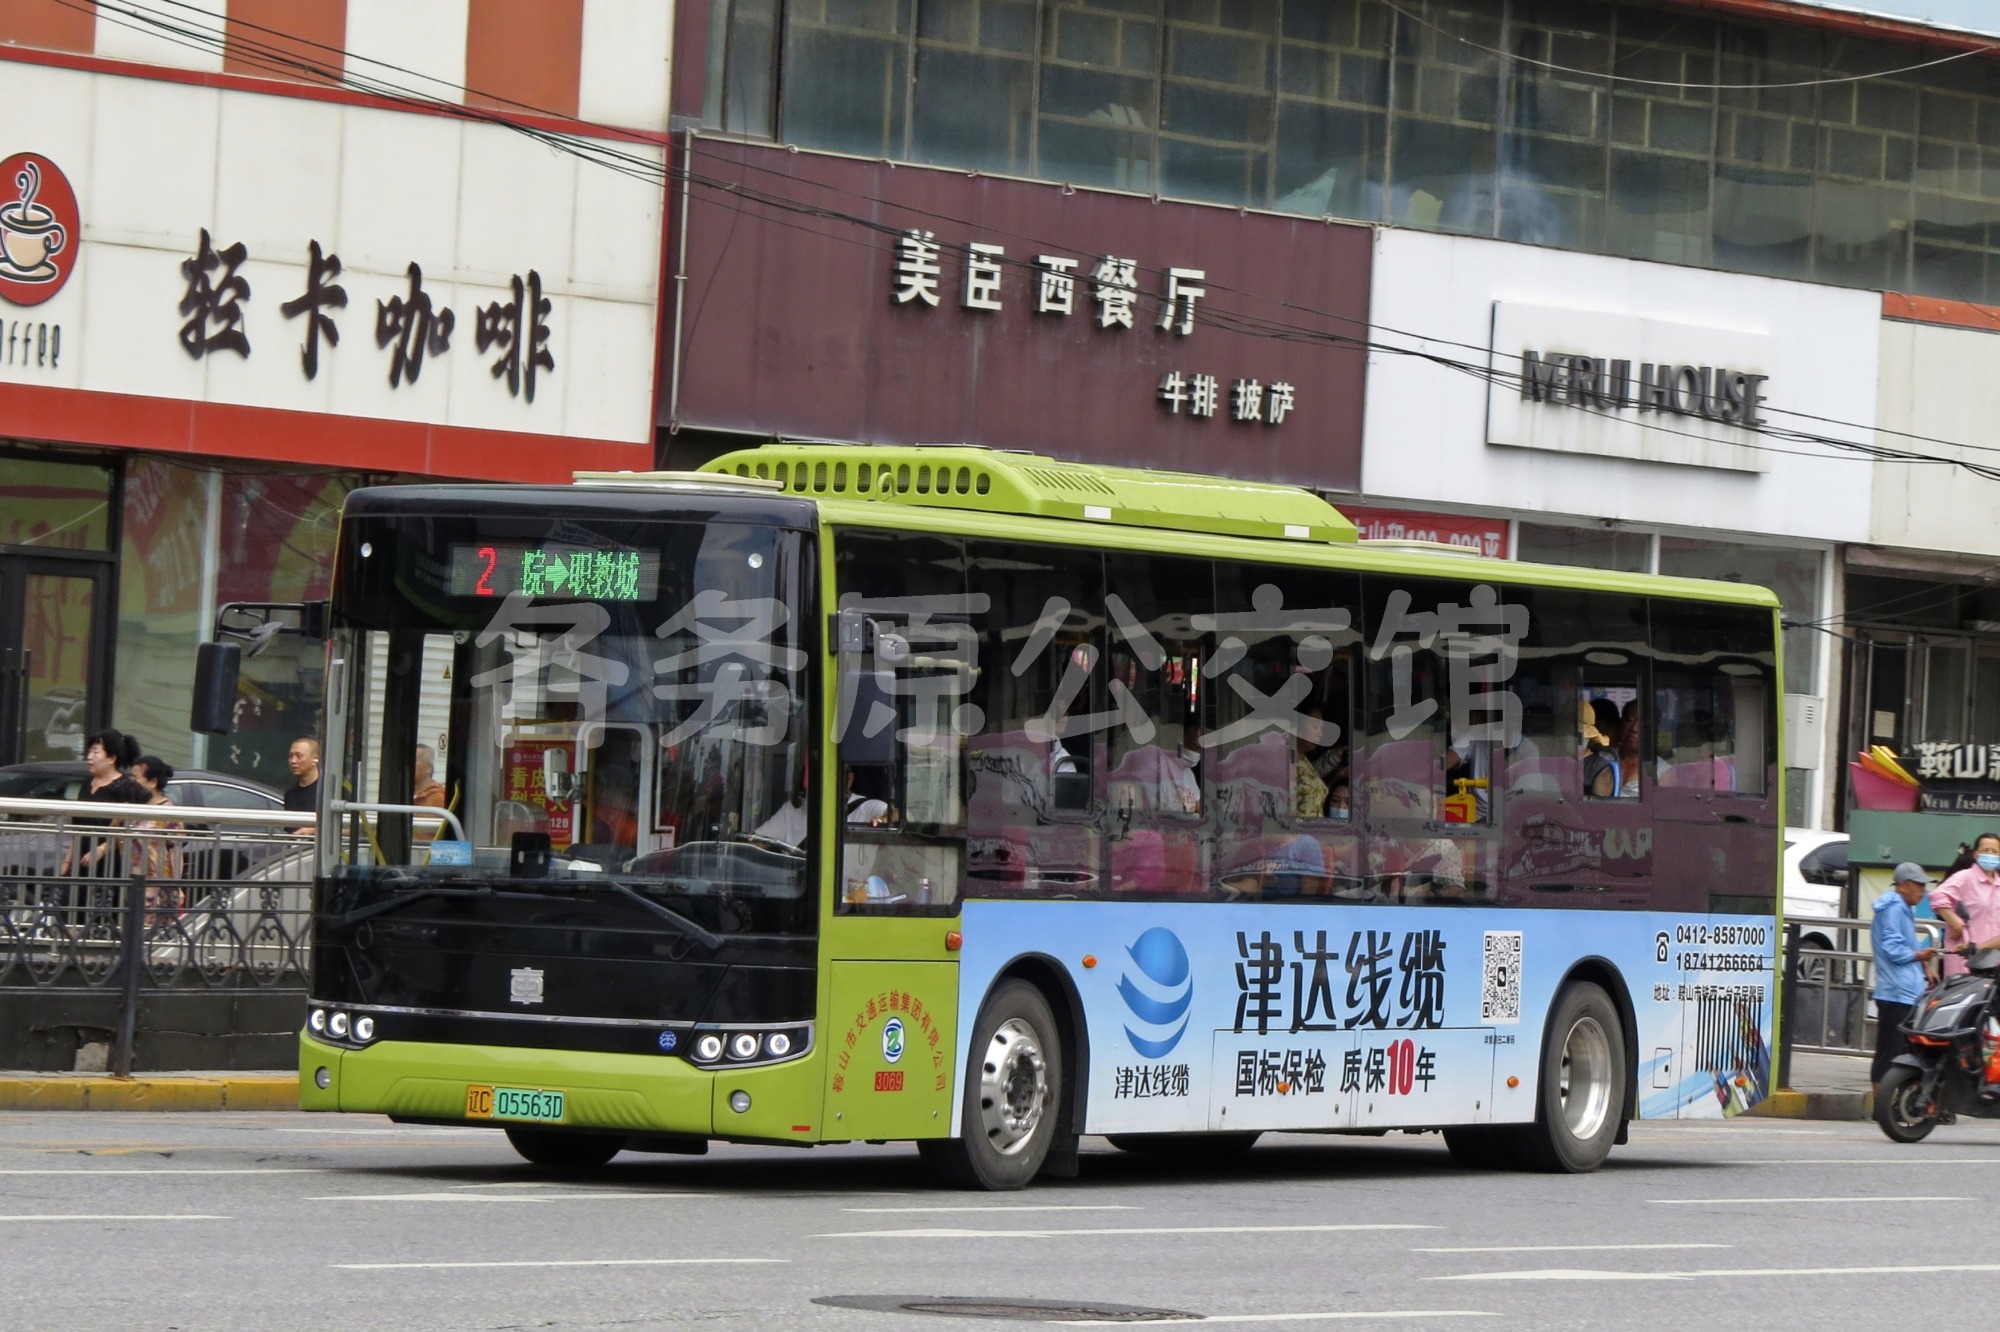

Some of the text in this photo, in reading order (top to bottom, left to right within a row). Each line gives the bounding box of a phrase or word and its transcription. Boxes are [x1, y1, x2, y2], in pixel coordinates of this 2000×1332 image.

[896, 229, 1206, 336] 美臣西餐厅
[1159, 372, 1295, 424] 牛排 披萨
[1639, 362, 1769, 426] HOUSE
[475, 547, 497, 596] 2
[1676, 925, 1766, 945] 0412-8587000
[1234, 930, 1446, 1036] 津达线缆
[1676, 952, 1763, 972] 18741266664
[832, 989, 946, 1094] 鞍山市交通运输集团有限公司
[1235, 1038, 1436, 1097] 国标保检 质保10年
[875, 1072, 902, 1090] 3069
[1114, 1063, 1190, 1099] 津达线缆
